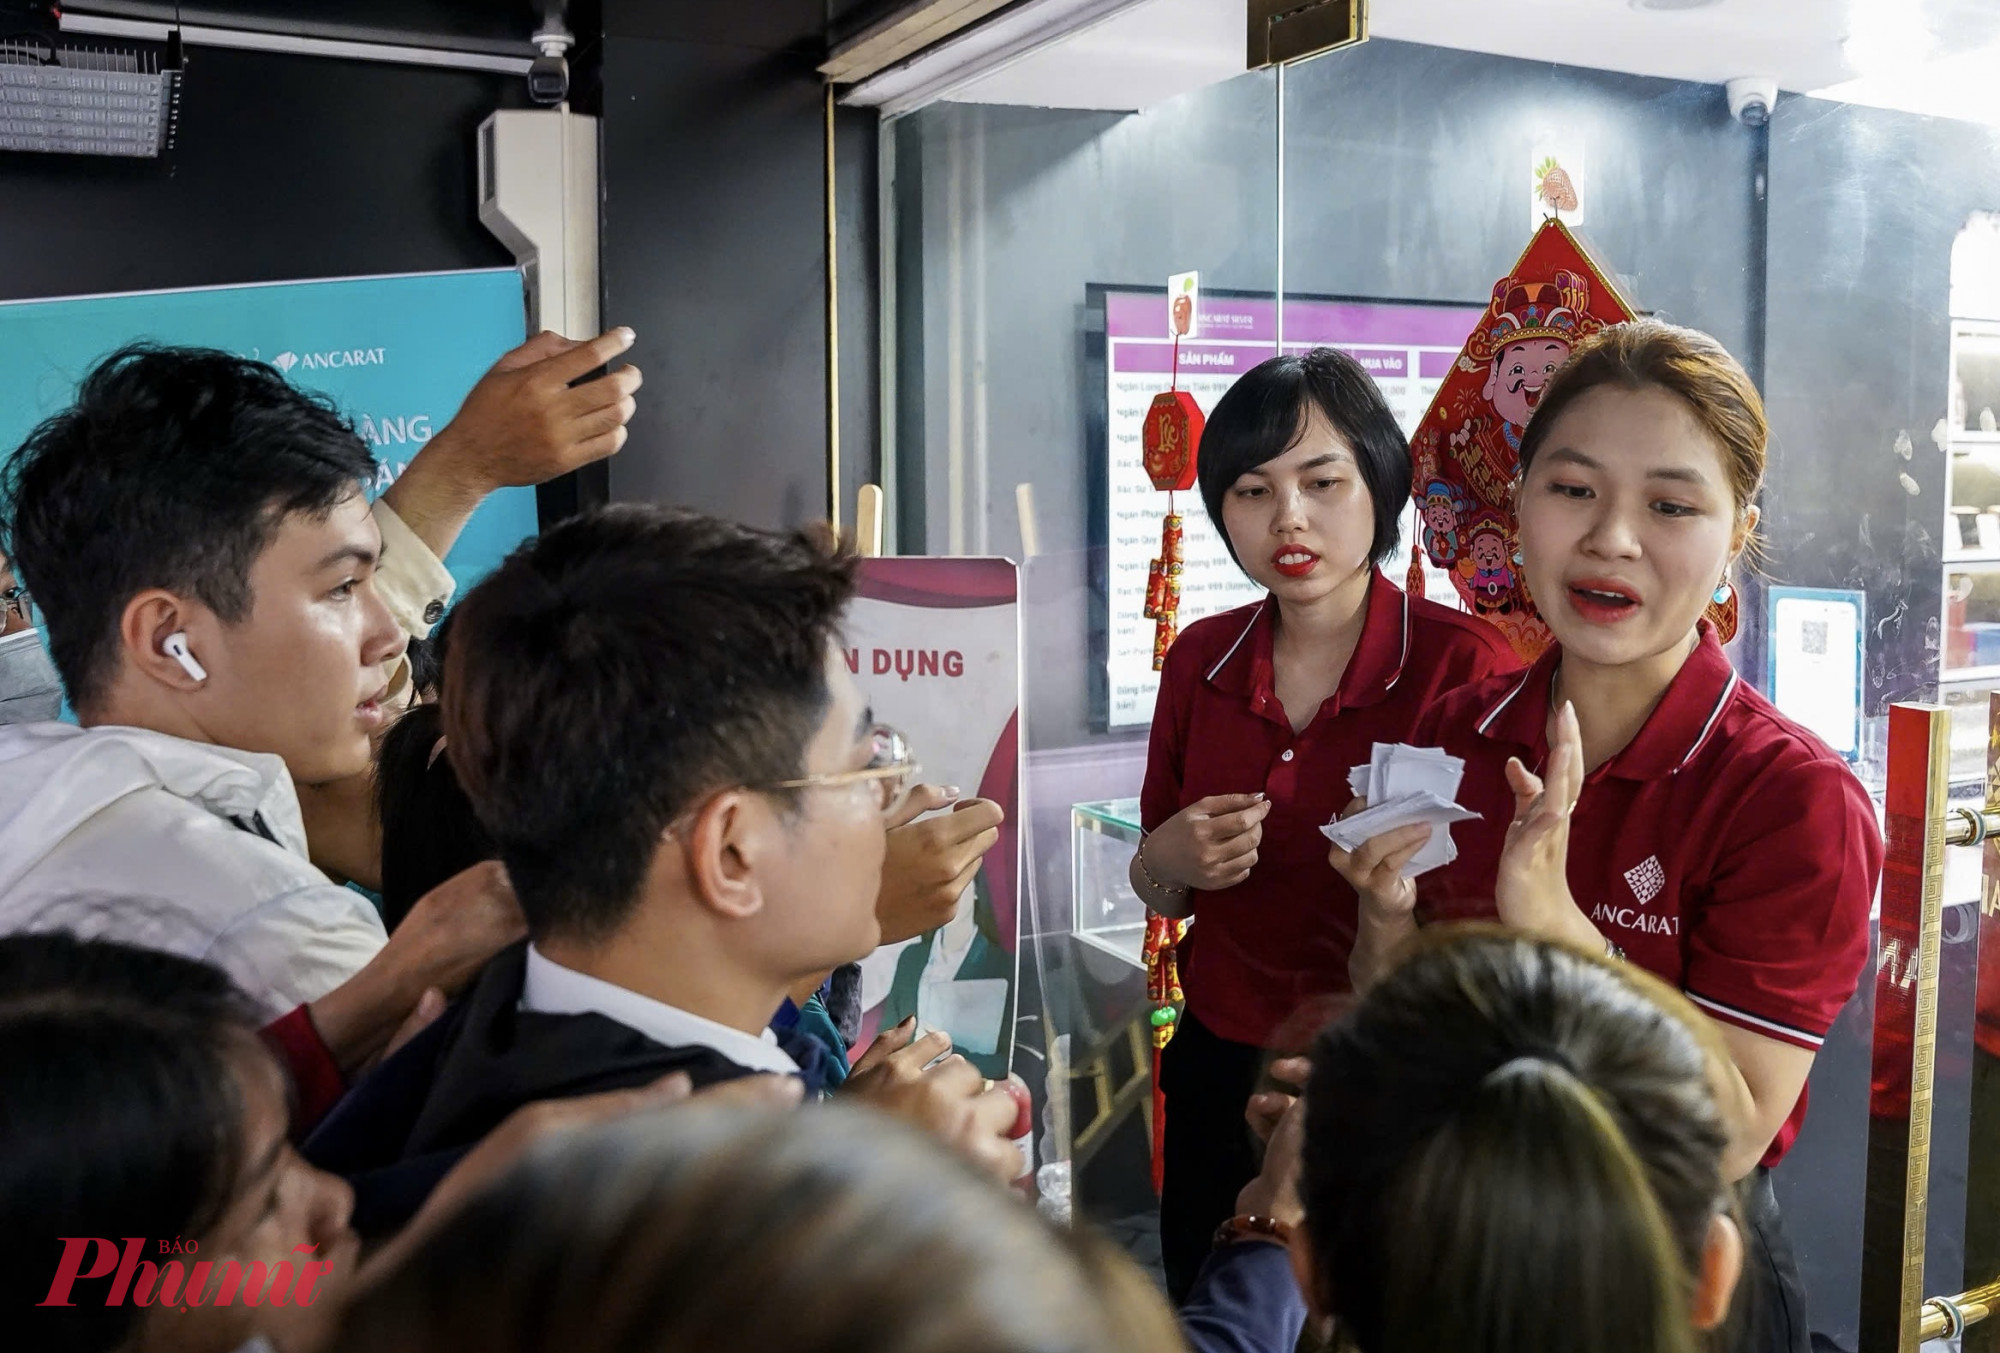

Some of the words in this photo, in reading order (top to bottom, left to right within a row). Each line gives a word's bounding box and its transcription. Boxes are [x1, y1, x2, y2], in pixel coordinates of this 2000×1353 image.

[302, 348, 386, 370] ANCARAT
[358, 413, 433, 446] ÀNG
[872, 648, 964, 682] DỤNG
[1590, 902, 1680, 936] ANCARAT
